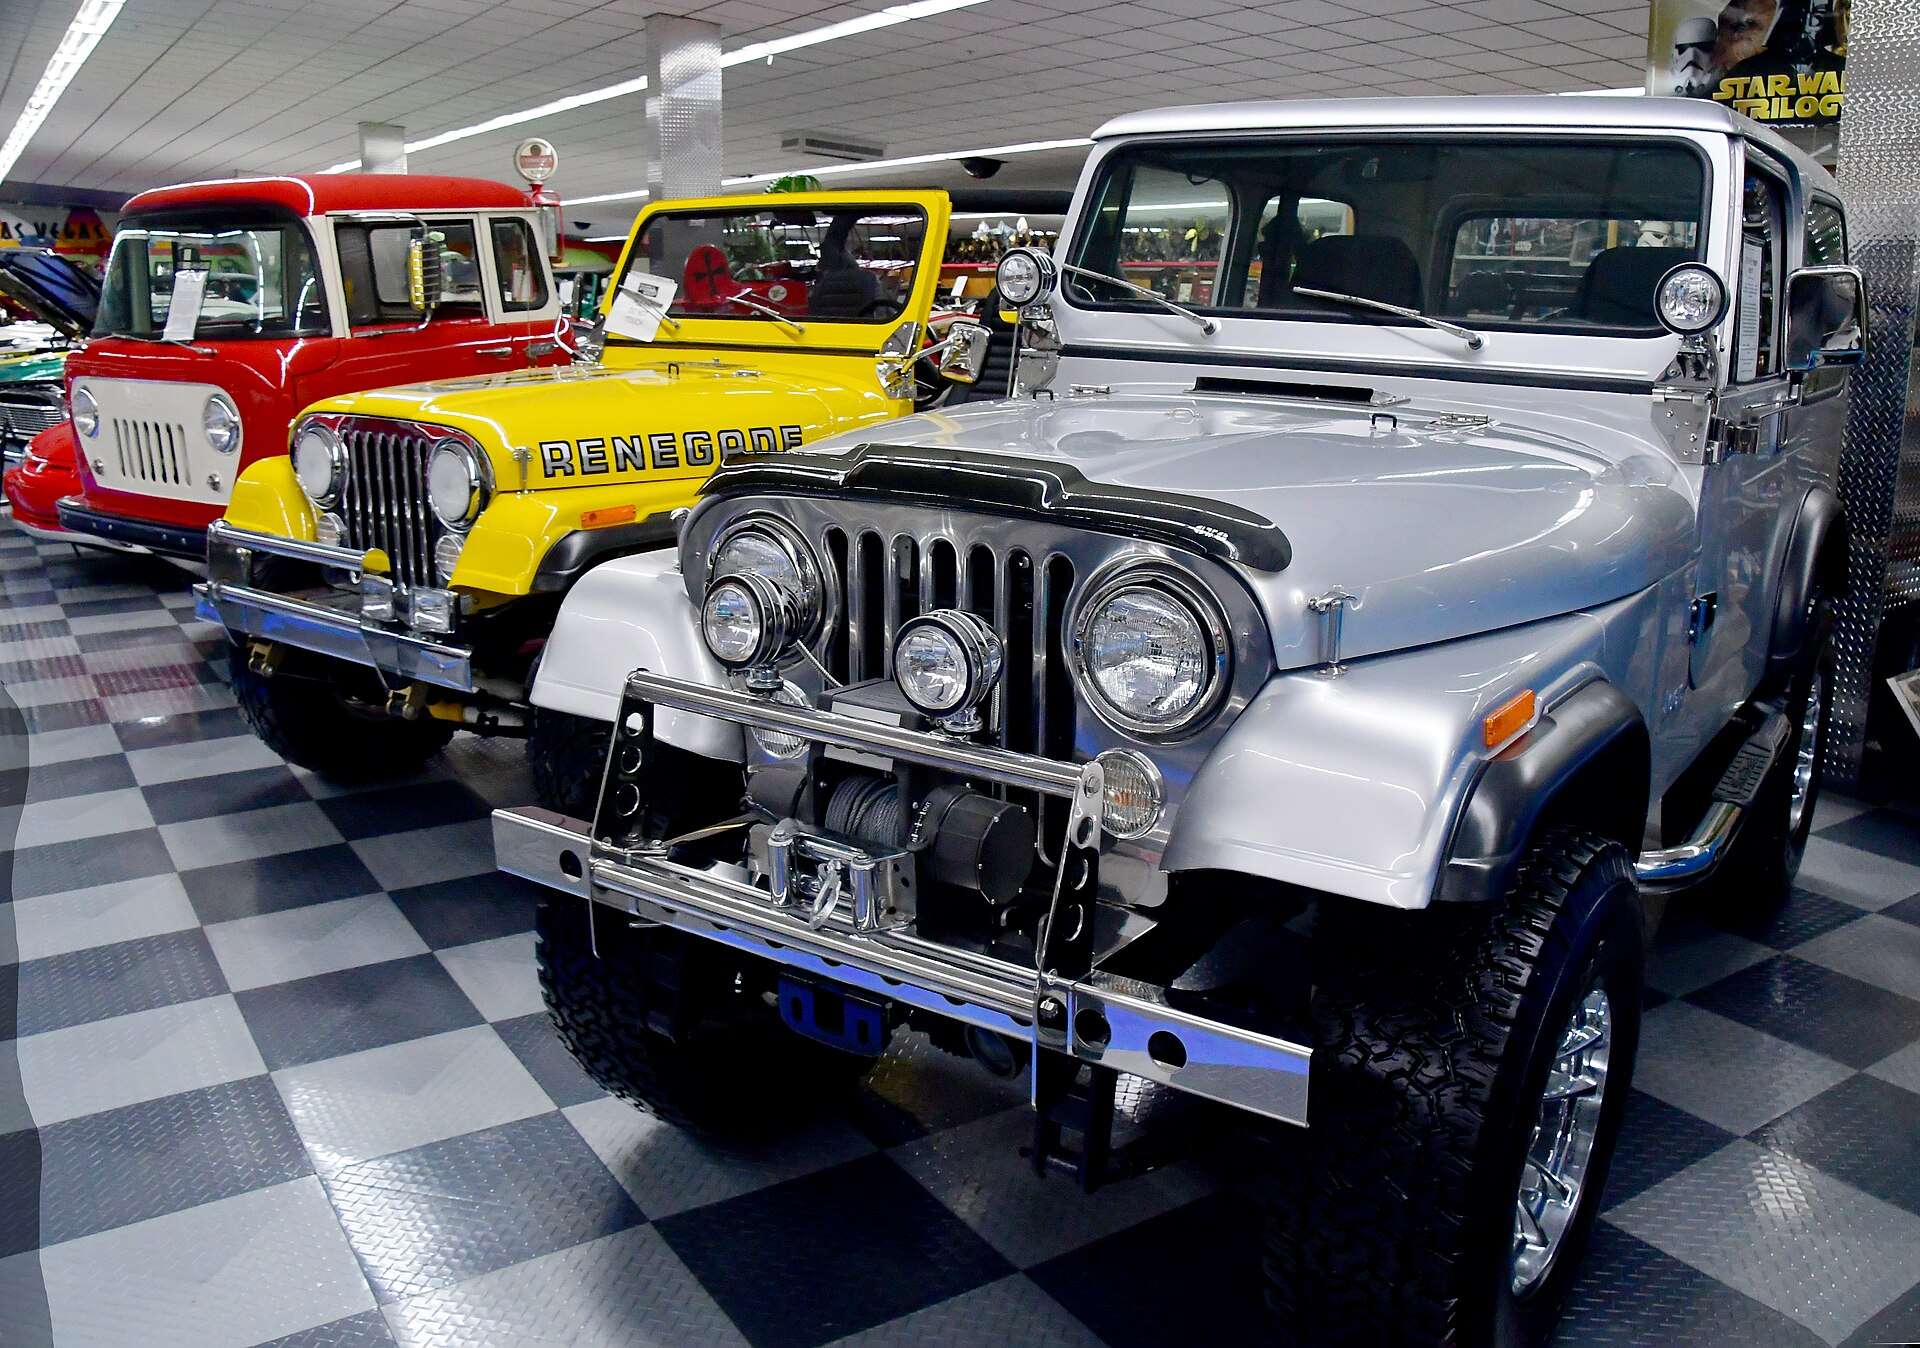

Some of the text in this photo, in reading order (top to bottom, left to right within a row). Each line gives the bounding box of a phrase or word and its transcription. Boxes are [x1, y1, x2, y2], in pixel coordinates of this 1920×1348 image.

[1713, 75, 1796, 100] STAR
[1733, 95, 1844, 119] TRILOG
[33, 222, 104, 239] VEGAS
[539, 425, 802, 478] RENEGADE
